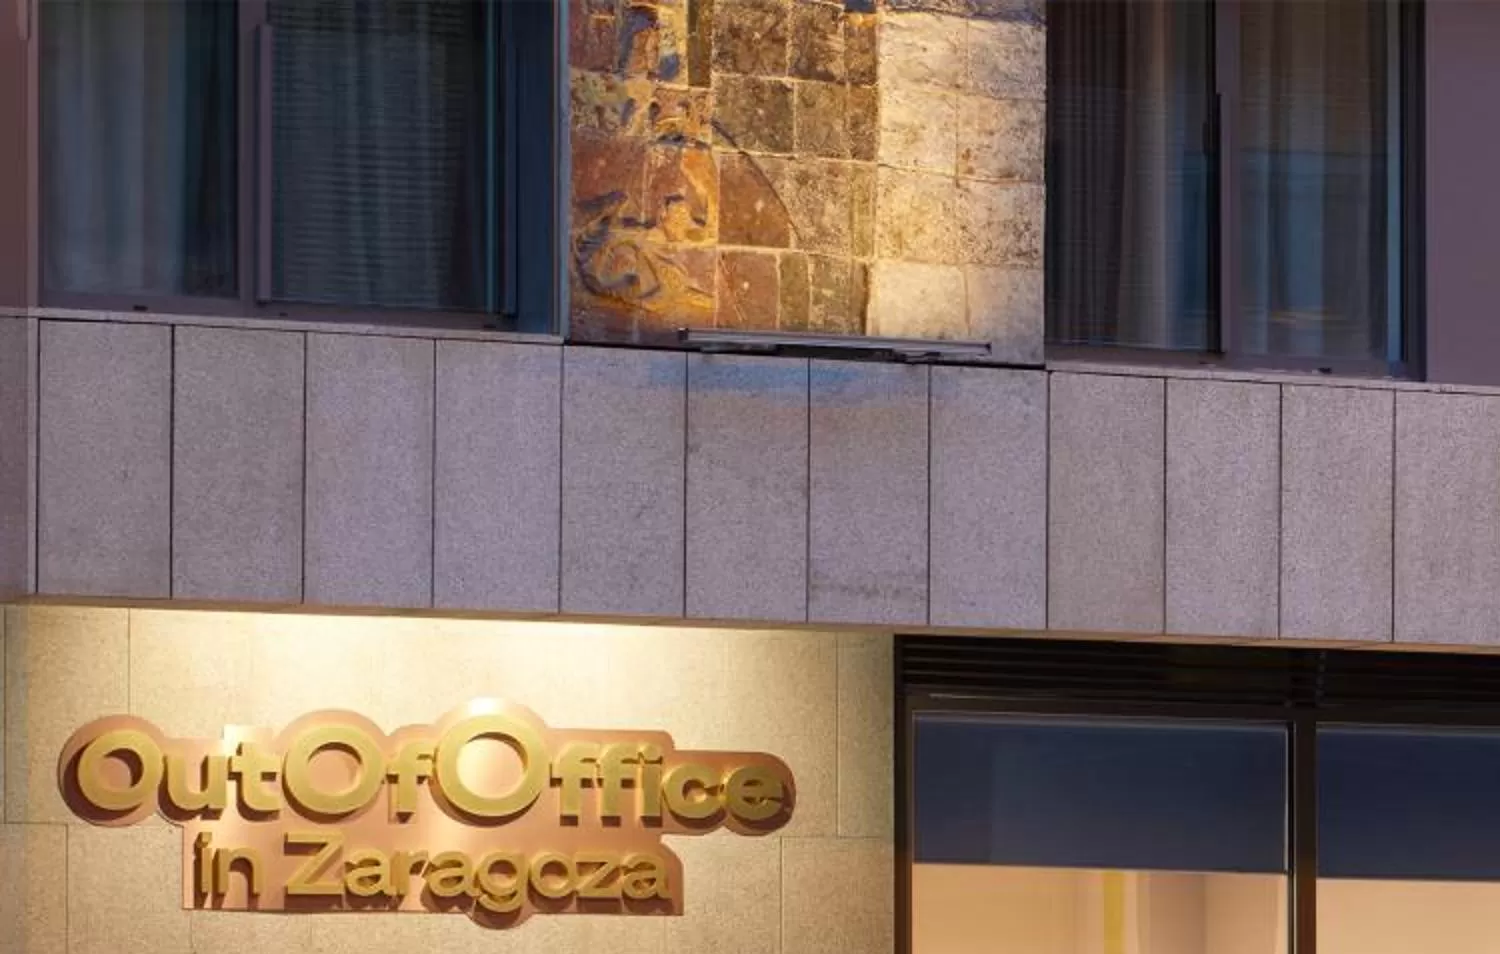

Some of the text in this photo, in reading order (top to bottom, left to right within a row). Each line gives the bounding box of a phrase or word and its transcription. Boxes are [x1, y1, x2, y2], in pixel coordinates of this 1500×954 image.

[76, 713, 785, 824] OutOfOffice
[197, 831, 676, 914] in Zaragoza
